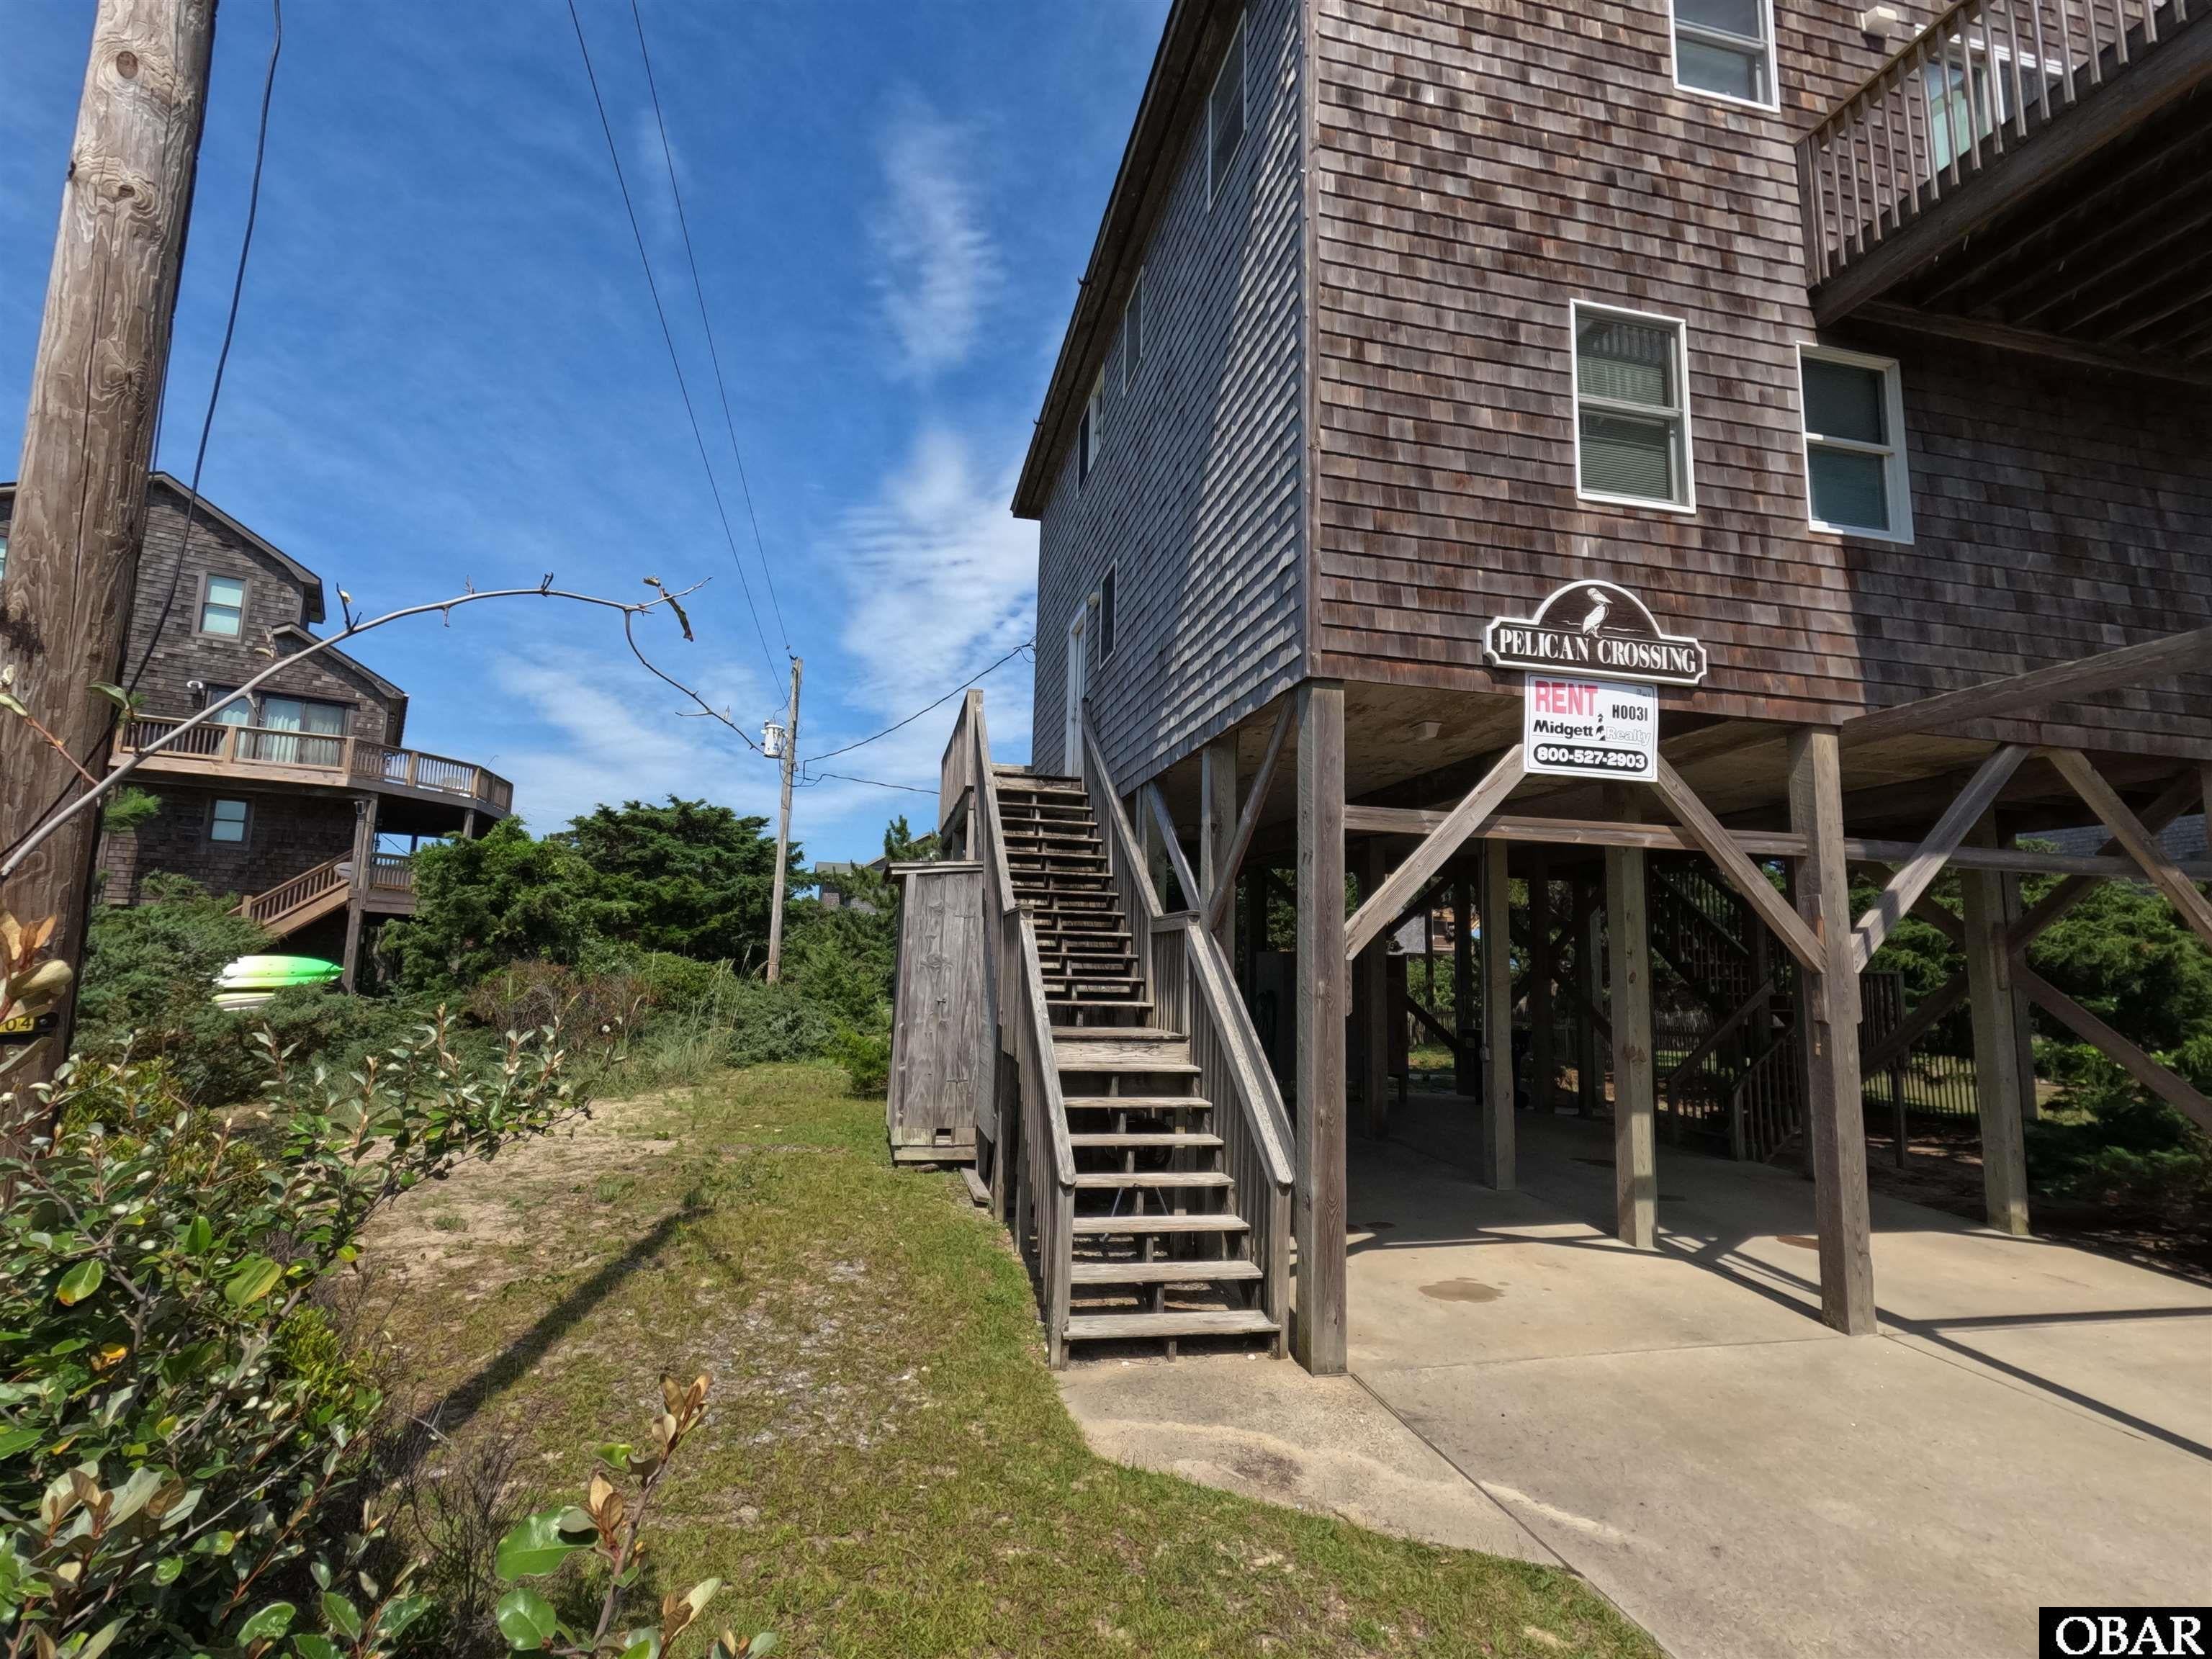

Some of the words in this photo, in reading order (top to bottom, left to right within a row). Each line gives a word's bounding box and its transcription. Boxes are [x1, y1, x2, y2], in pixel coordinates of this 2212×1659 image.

[1498, 629, 1590, 662] PELICAN
[1598, 639, 1696, 673] CROSSING
[1535, 680, 1598, 716] RENT
[1533, 719, 1593, 739] Midgett
[1606, 726, 1651, 746] Realty
[1537, 746, 1645, 768] 800-527-2903
